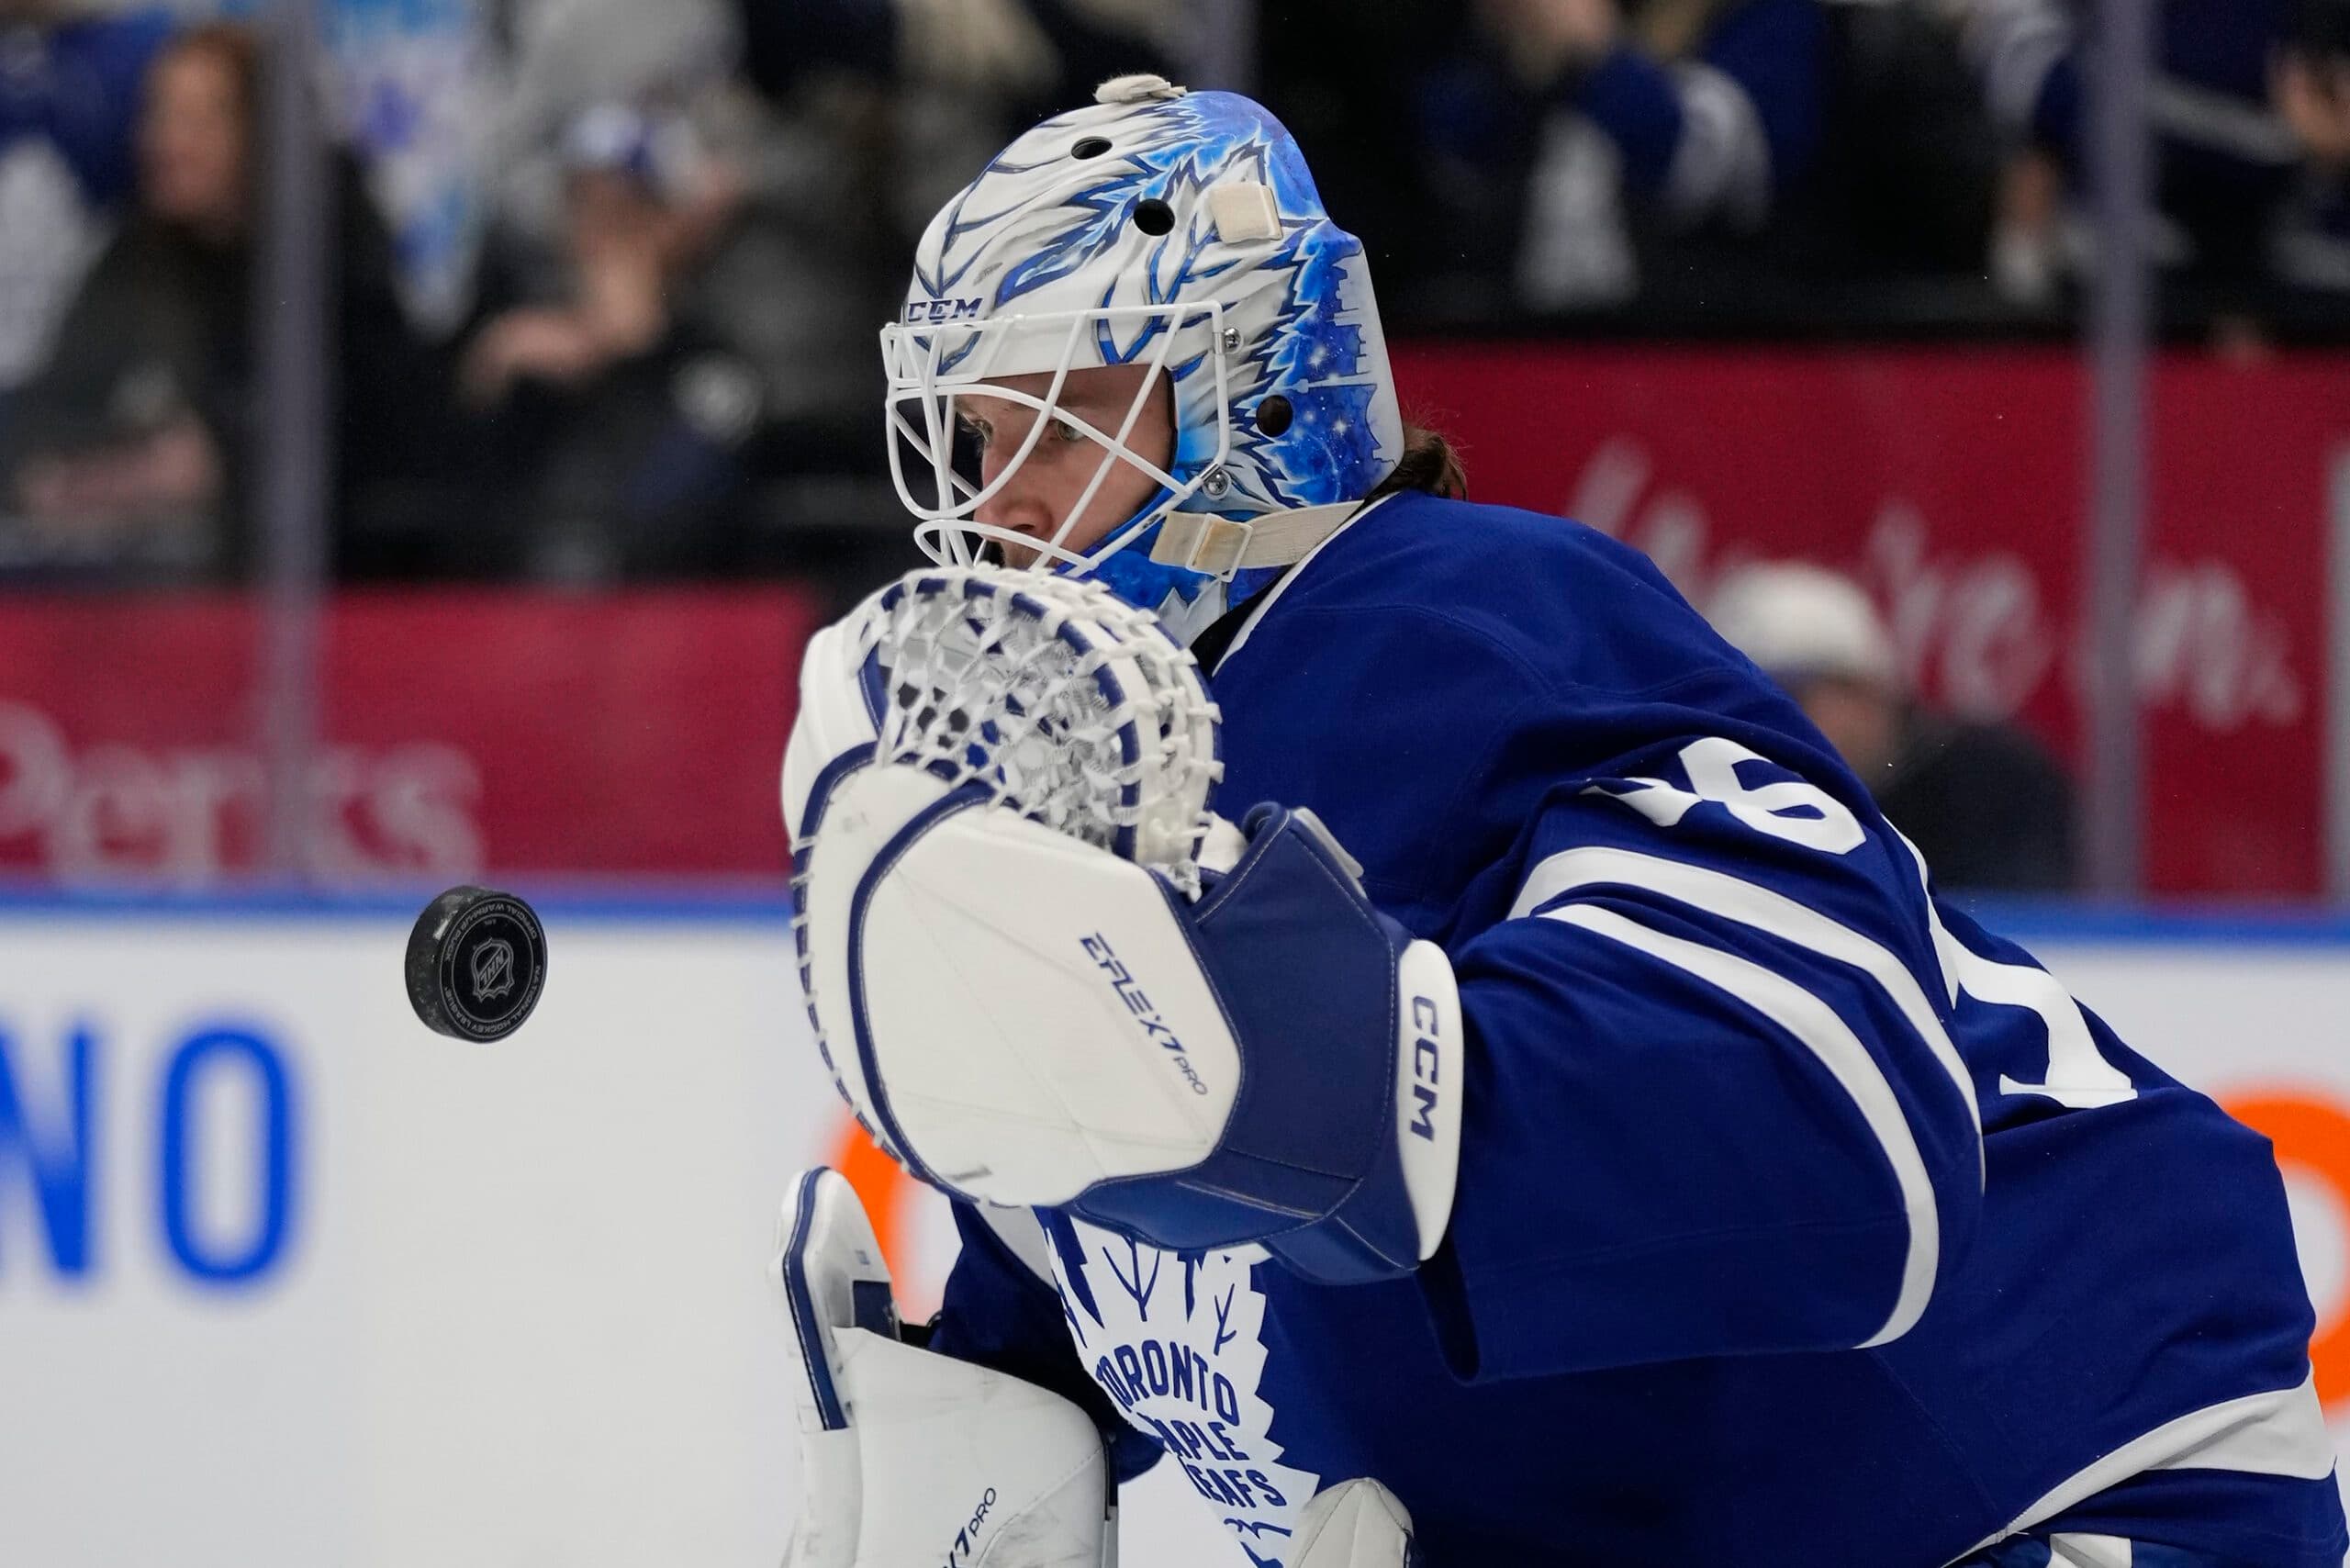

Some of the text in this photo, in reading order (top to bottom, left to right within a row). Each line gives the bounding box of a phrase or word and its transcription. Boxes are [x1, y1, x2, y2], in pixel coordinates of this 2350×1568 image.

[908, 297, 983, 322] CCM
[480, 951, 505, 985] NHL
[511, 965, 543, 1021] NATIONAL
[471, 1019, 511, 1033] HOCKEY
[1173, 1056, 1208, 1095] PRO
[1409, 995, 1441, 1143] CCM
[968, 1487, 997, 1538] PRO
